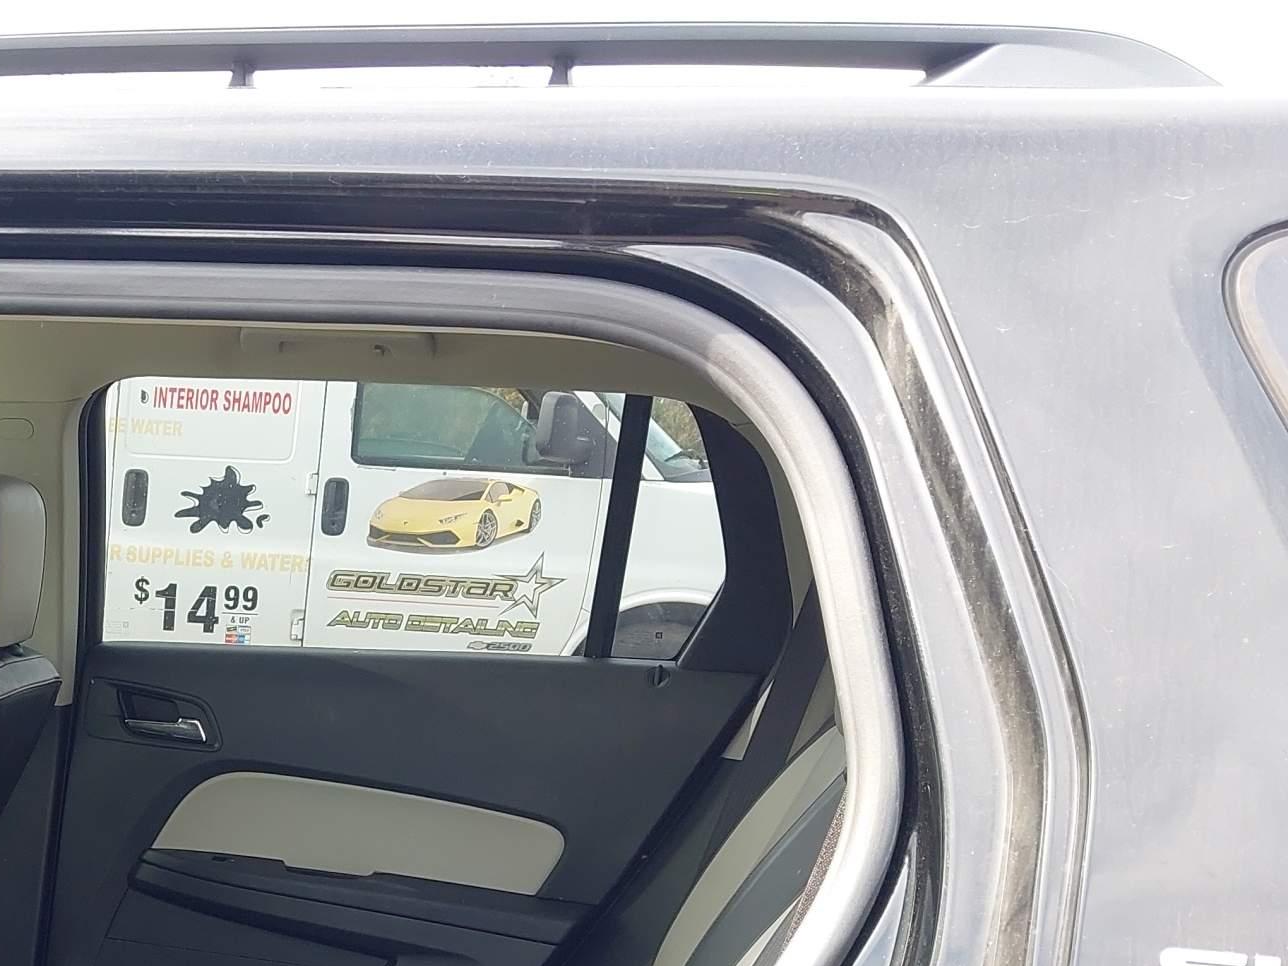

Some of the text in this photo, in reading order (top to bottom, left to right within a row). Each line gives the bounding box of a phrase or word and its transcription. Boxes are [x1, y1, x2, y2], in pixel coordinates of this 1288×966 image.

[153, 386, 292, 415] INTERIOR SHAMPOO
[131, 417, 184, 436] WATER
[126, 544, 215, 568] SUPPLIES
[326, 570, 518, 601] GOLDSTAR
[238, 616, 250, 624] UP
[326, 610, 541, 639] AUTO DETAILING
[487, 641, 532, 652] 2500
